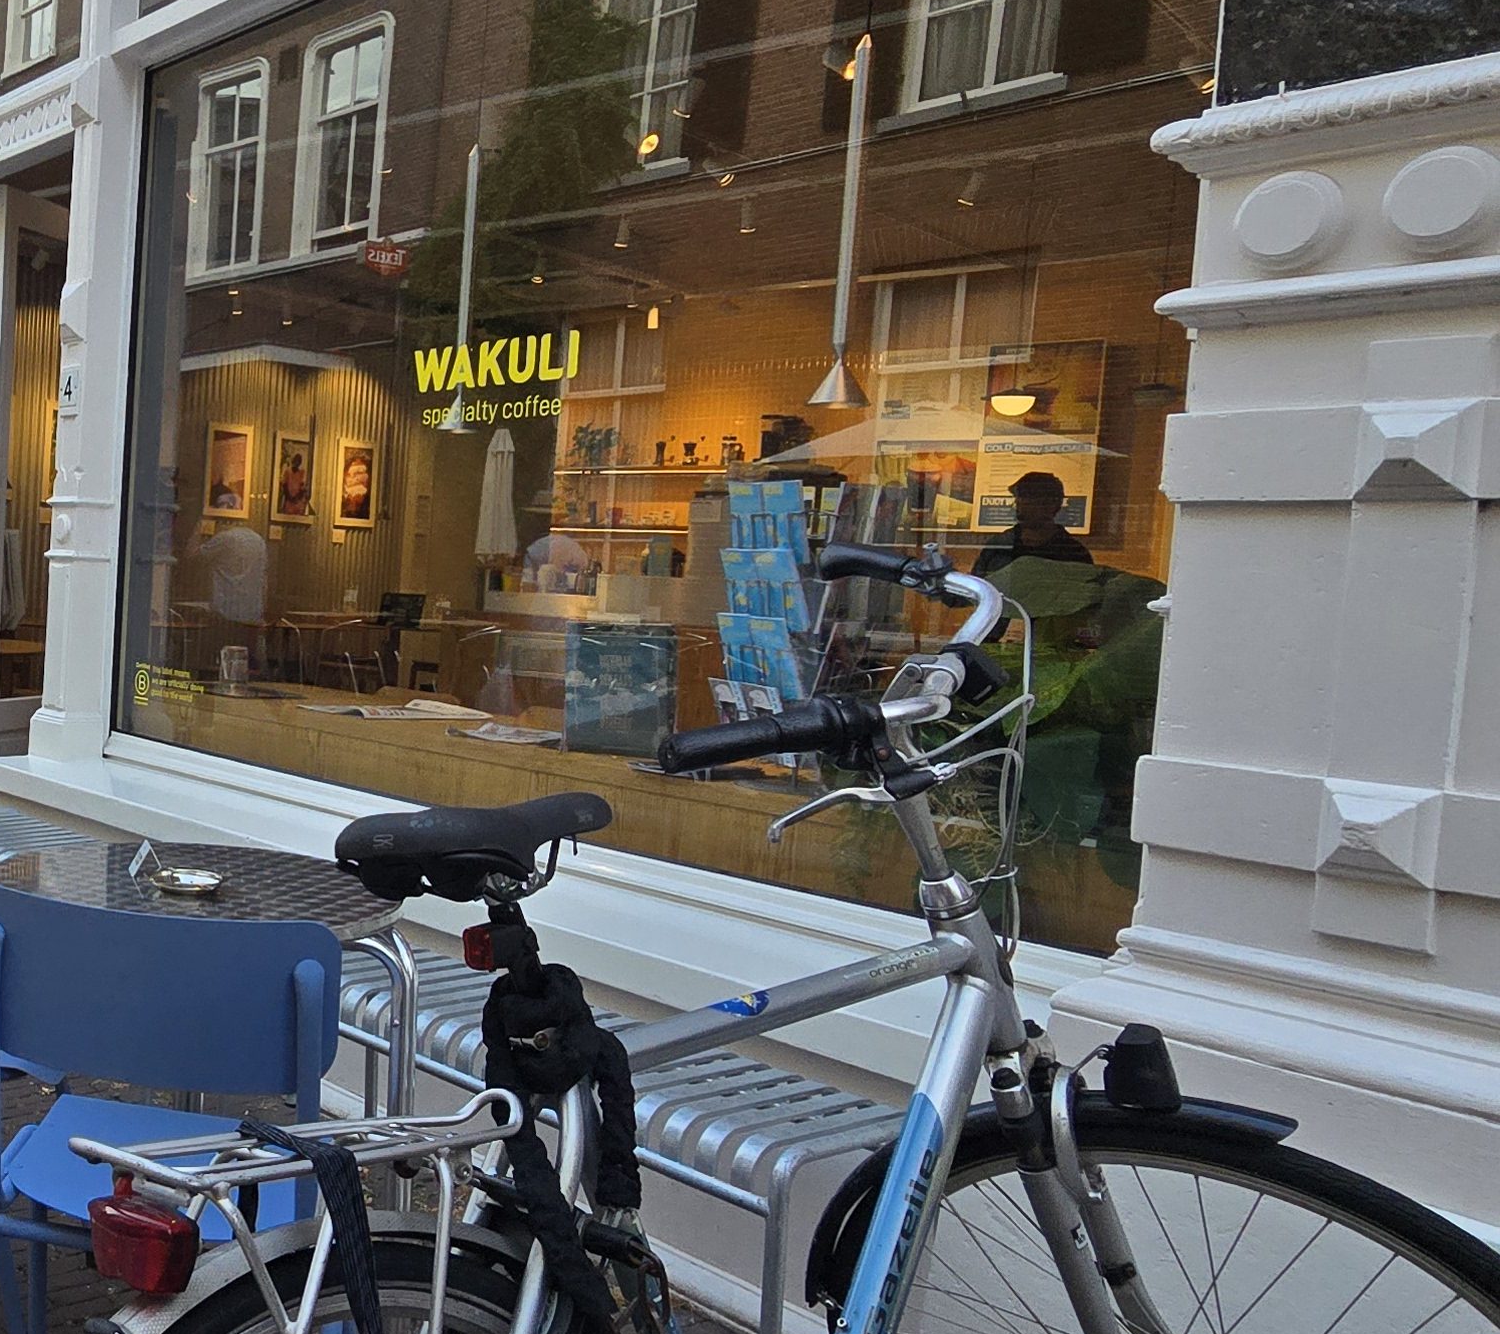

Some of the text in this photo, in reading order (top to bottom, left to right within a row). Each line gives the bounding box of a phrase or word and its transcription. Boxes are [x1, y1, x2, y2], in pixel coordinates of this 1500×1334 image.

[414, 329, 581, 394] WAKULI
[63, 375, 73, 402] 4
[422, 394, 562, 429] specialty coffee
[985, 443, 1013, 453] COLD
